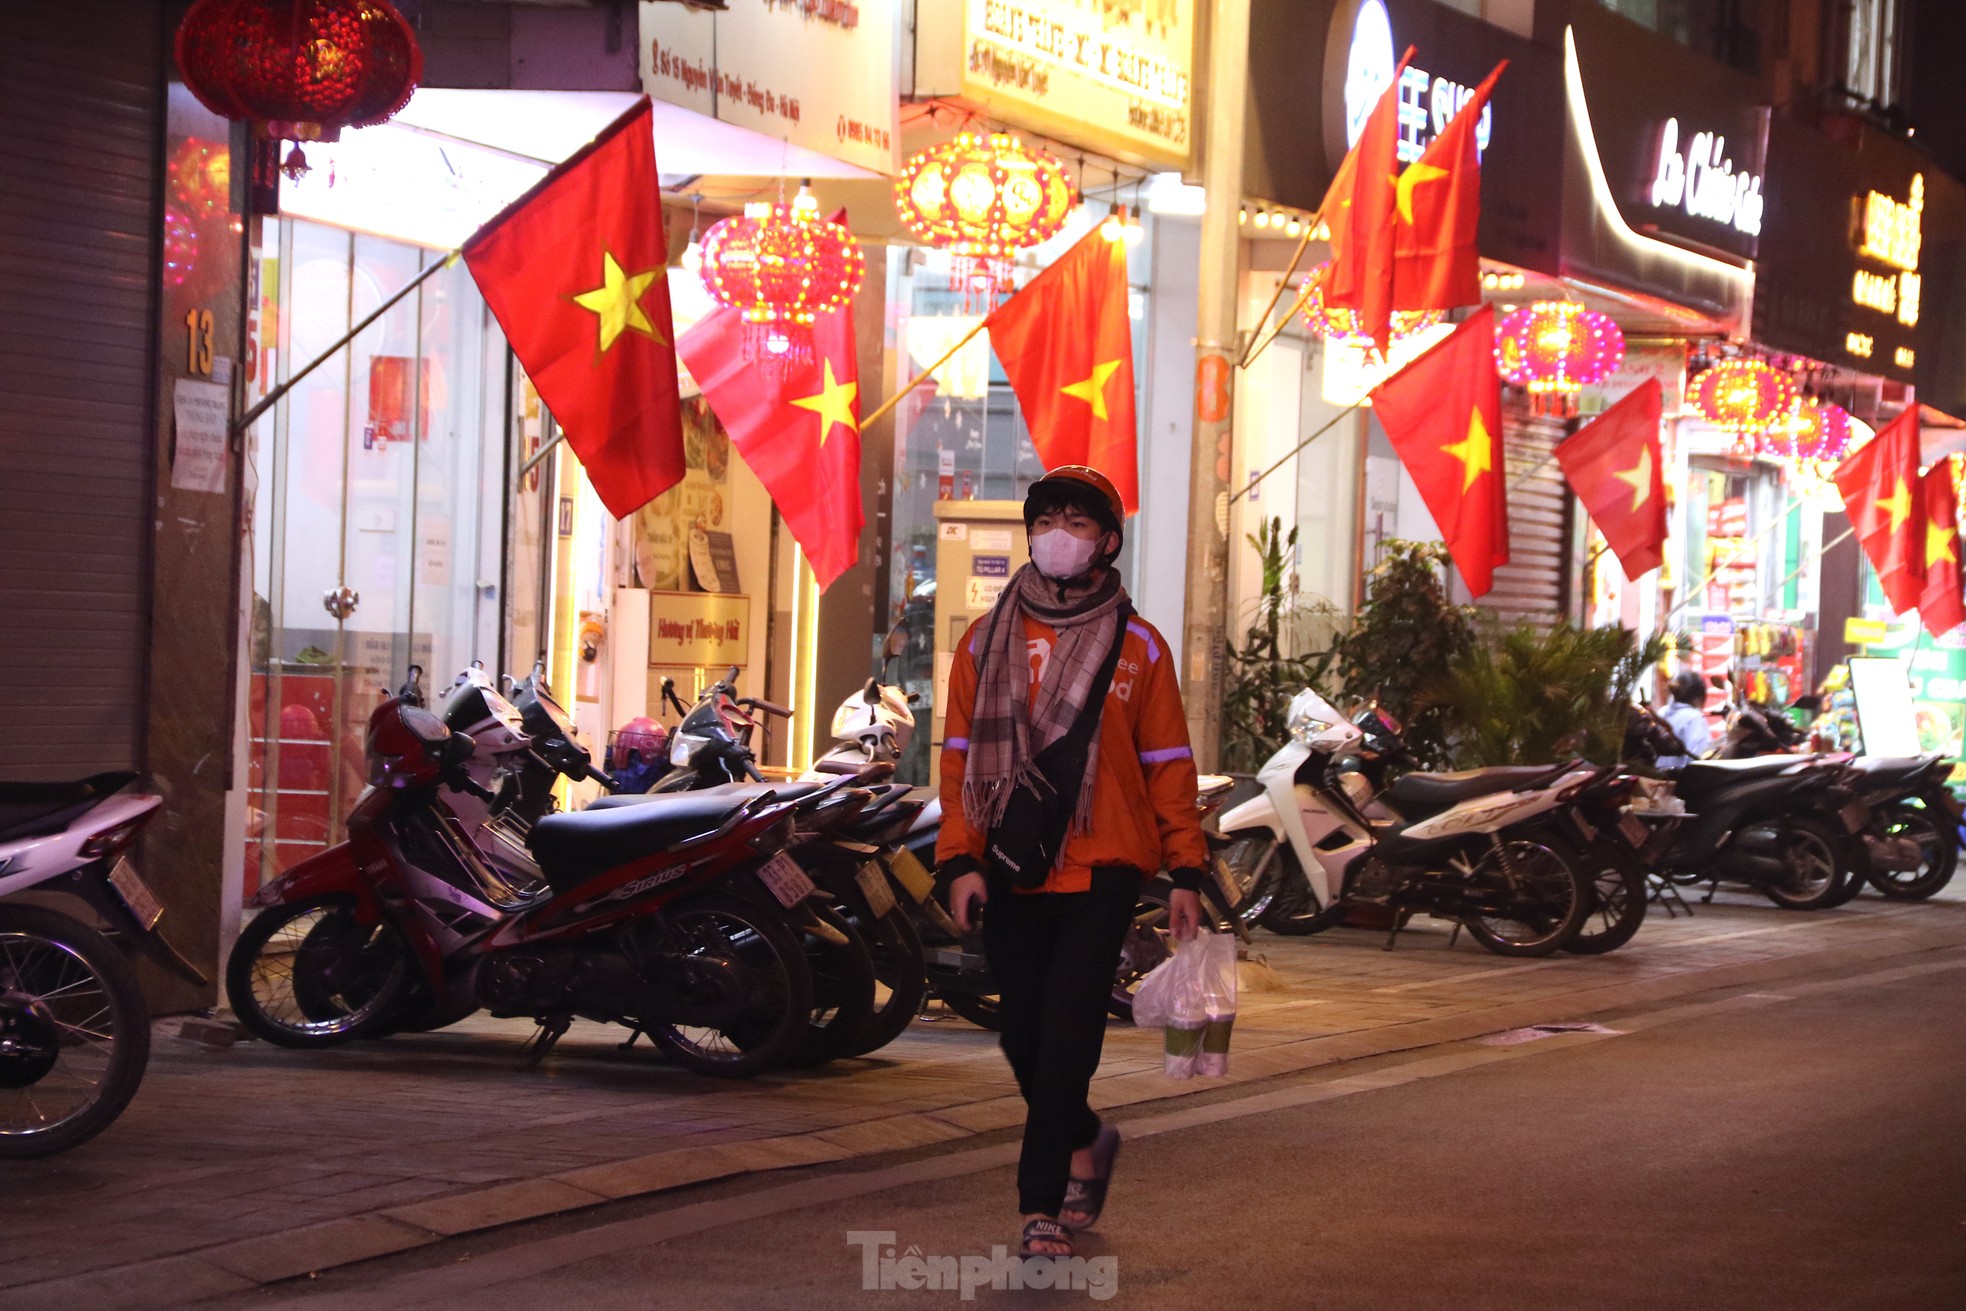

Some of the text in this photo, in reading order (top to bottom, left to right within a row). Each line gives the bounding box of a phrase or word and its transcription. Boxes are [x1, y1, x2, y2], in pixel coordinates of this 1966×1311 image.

[186, 308, 214, 375] 13
[658, 618, 685, 646] Hương
[686, 620, 694, 644] vị
[992, 844, 1020, 872] Supreme
[1036, 1221, 1062, 1233] NIKE
